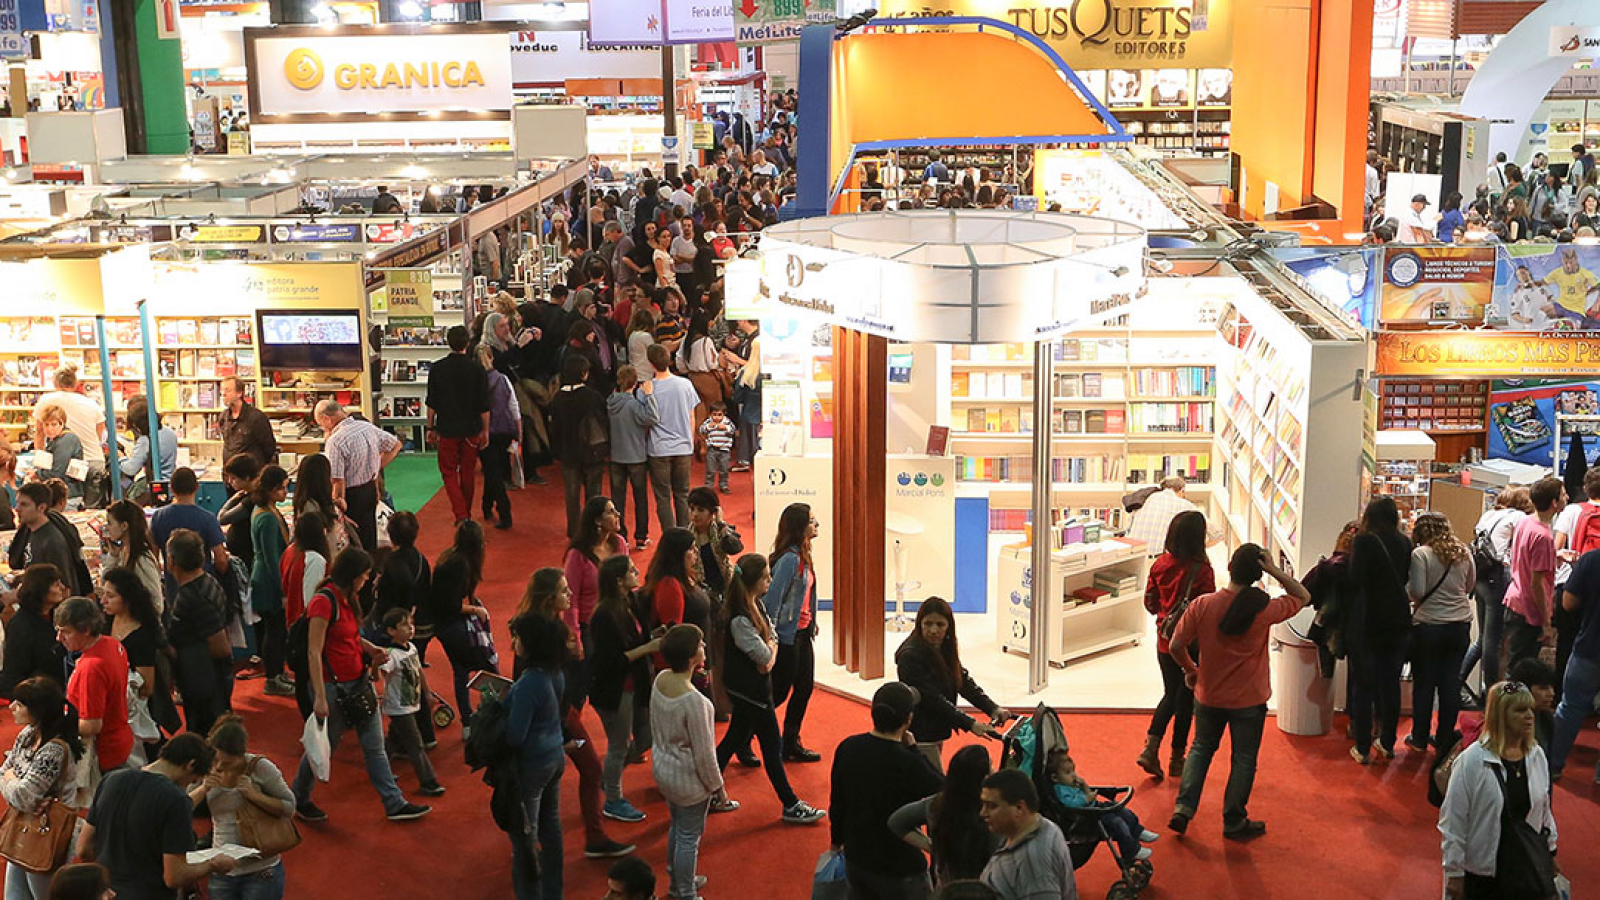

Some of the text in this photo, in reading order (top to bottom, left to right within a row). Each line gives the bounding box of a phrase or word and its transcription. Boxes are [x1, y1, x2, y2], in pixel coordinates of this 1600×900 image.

[1008, 0, 1191, 45] TUSQUETS
[1114, 42, 1186, 55] EDITORES
[335, 60, 485, 90] GRANICA
[266, 277, 295, 286] editora
[292, 285, 320, 295] grande
[390, 287, 417, 296] PATRIA
[390, 297, 419, 305] GRANDE
[1400, 340, 1442, 363] LOS
[1445, 340, 1519, 363] LIBROS
[1523, 340, 1571, 363] MAS
[896, 488, 945, 497] Marcial Pons
